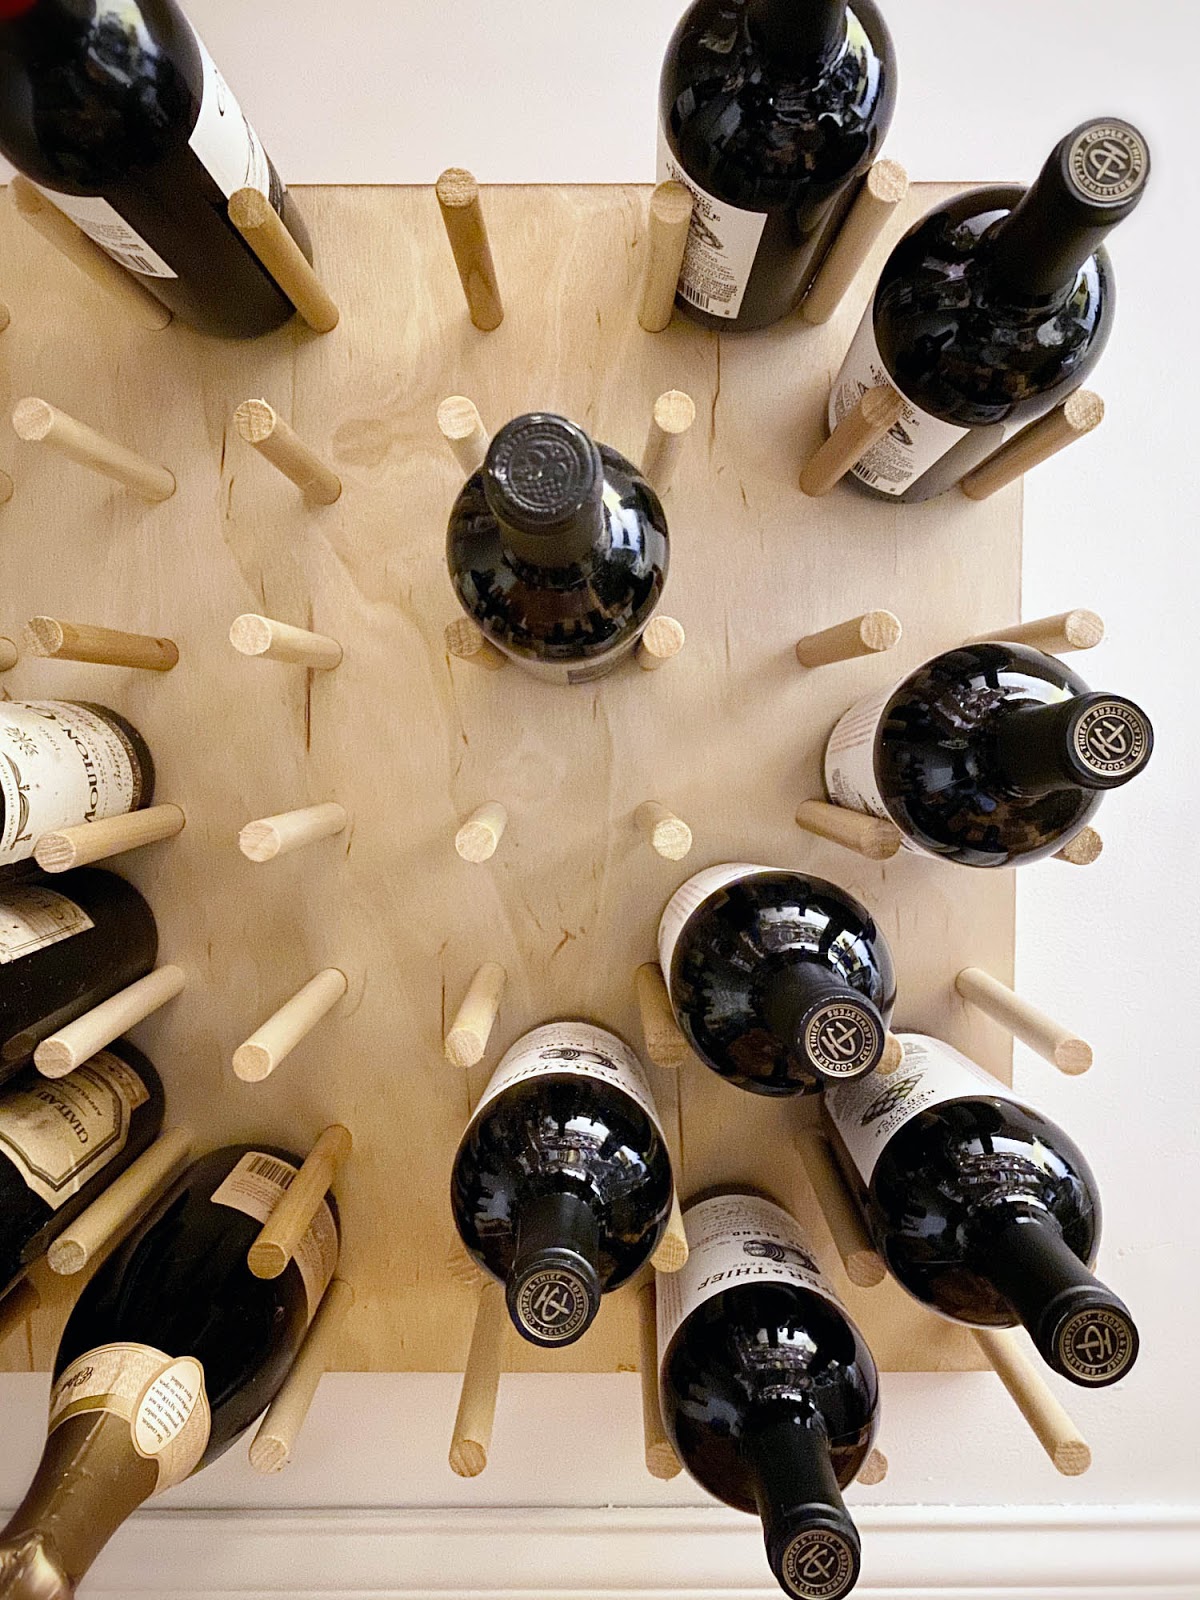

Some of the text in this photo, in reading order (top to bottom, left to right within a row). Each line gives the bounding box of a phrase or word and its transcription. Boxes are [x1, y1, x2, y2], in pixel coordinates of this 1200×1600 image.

[1085, 129, 1124, 143] COOPER
[1130, 142, 1142, 172] THIEF
[1078, 722, 1088, 751] THIEF
[1088, 757, 1127, 771] COOPER
[810, 1020, 820, 1048] THIEF
[818, 1057, 853, 1071] COOPER
[697, 1267, 769, 1291] THIEF
[522, 1290, 536, 1325] COOPER
[535, 1274, 562, 1284] THIEF
